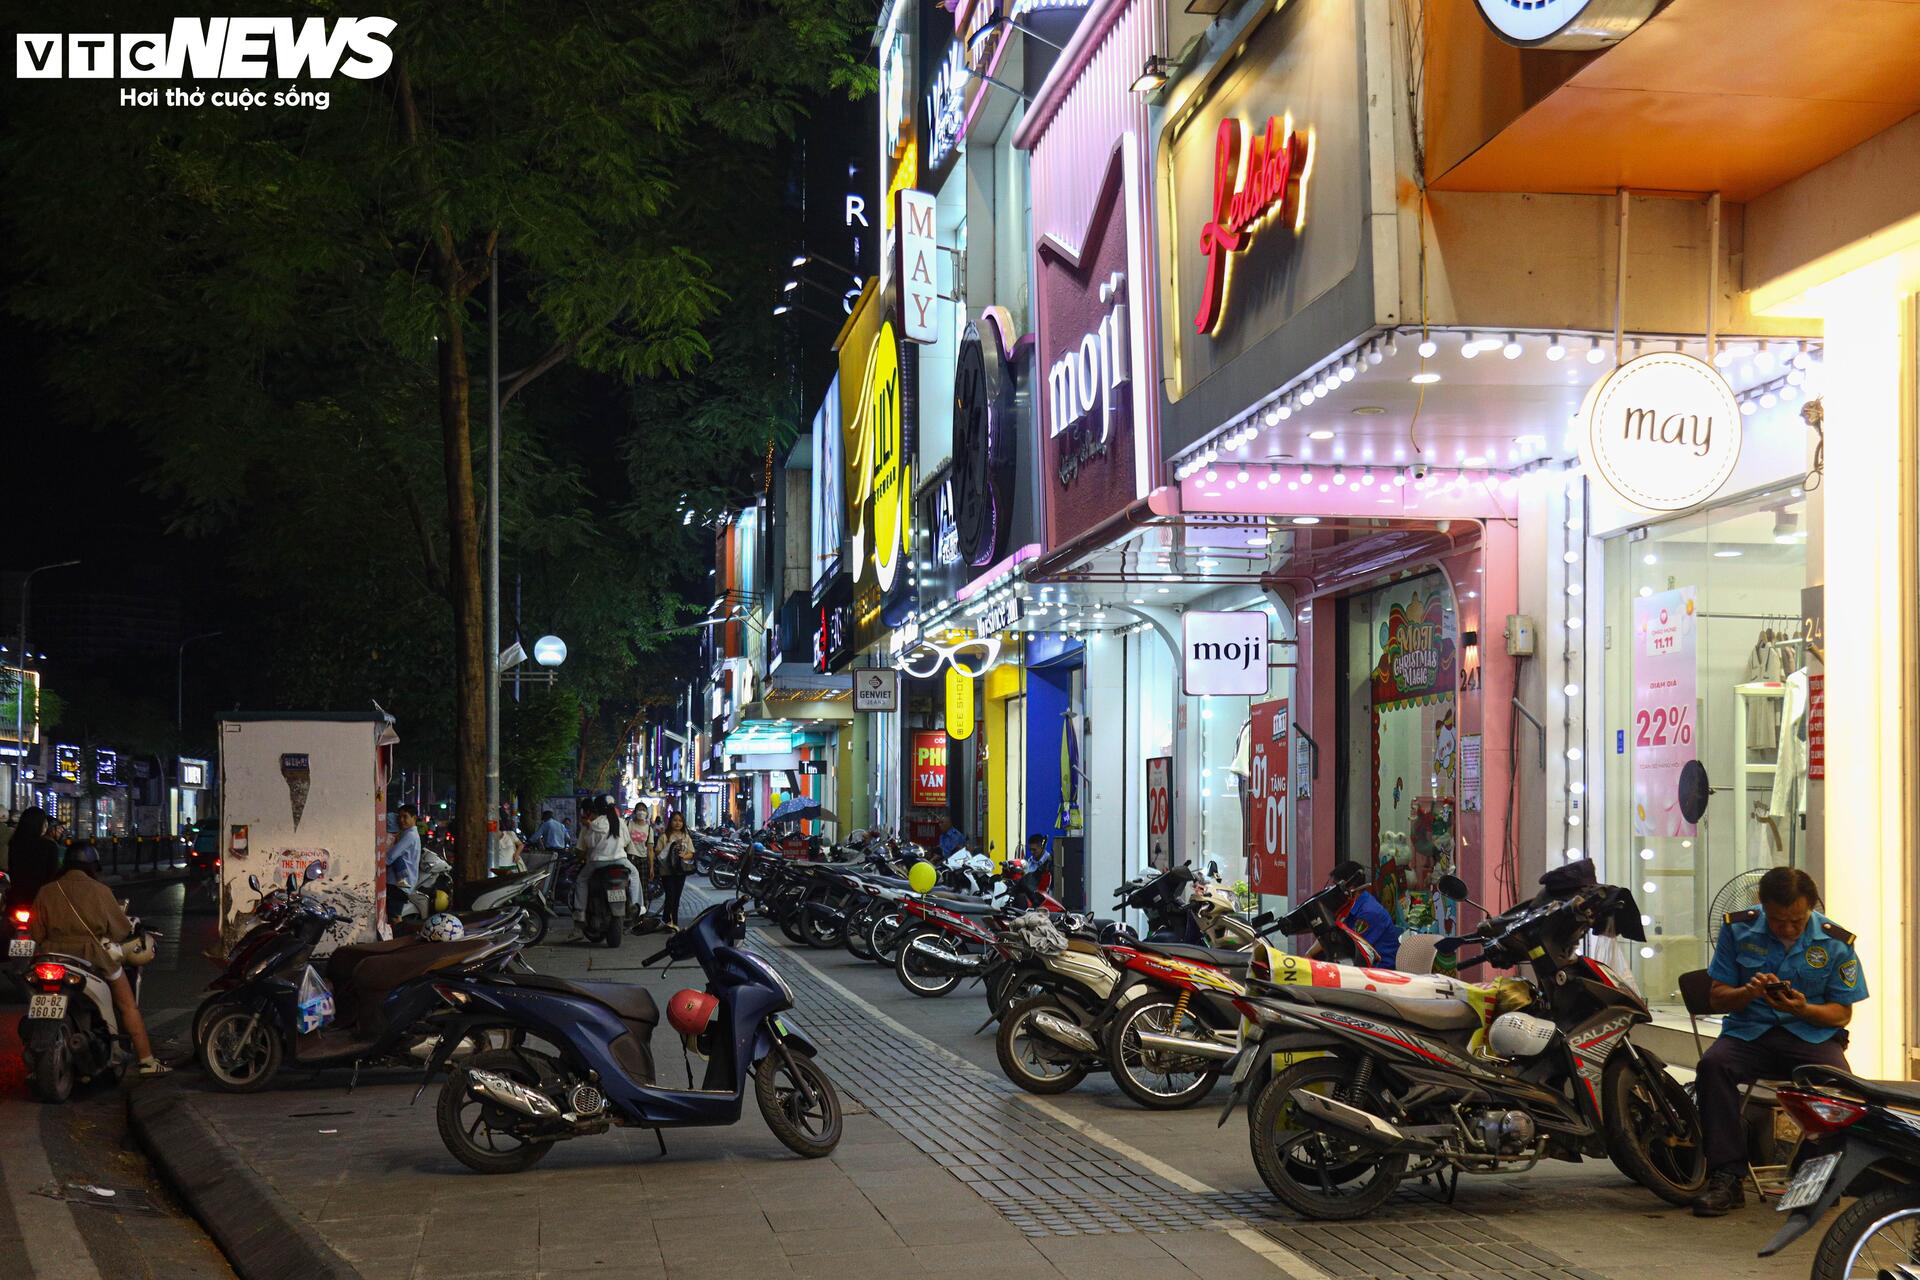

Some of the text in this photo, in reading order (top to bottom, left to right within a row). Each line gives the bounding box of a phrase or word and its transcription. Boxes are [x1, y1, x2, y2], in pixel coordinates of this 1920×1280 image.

[907, 202, 934, 329] MAY
[1049, 272, 1126, 443] moji
[873, 367, 897, 477] LILY
[1624, 407, 1713, 457] may
[1193, 636, 1261, 670] moji
[1654, 636, 1673, 649] 11.11
[859, 690, 892, 699] GENVIET
[1636, 706, 1691, 747] 22%
[920, 770, 943, 787] VĂN
[1252, 755, 1267, 799] 01
[1265, 796, 1286, 855] 01
[31, 1007, 63, 1018] 360.87
[1569, 1013, 1634, 1046] GALAXY
